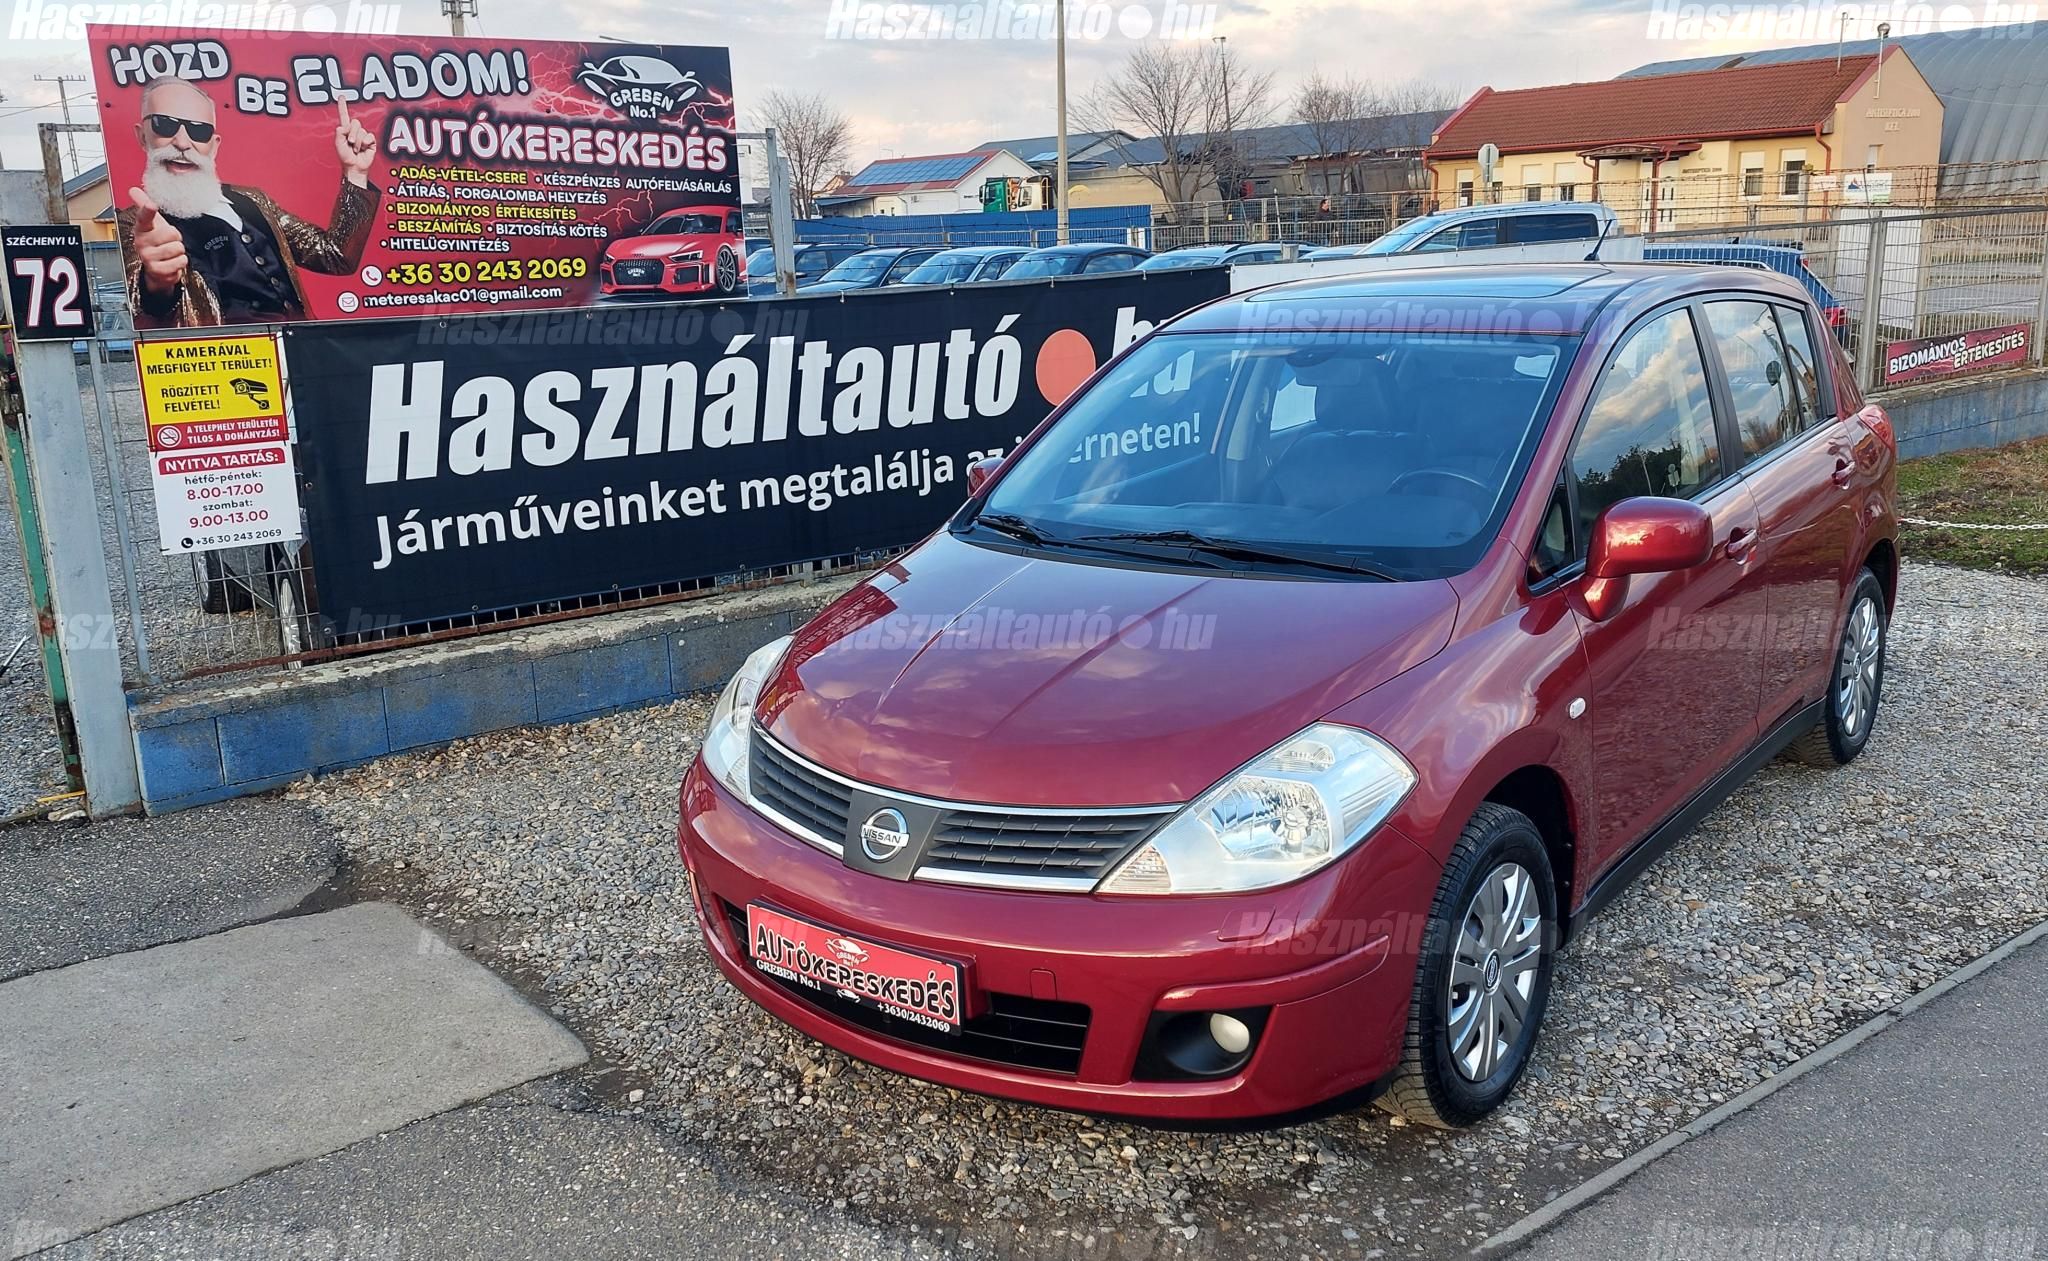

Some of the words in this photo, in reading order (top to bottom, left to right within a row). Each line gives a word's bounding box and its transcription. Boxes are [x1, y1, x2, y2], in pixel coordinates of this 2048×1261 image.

[109, 41, 231, 86] HOZD
[293, 50, 530, 104] ELADOM!
[237, 77, 289, 116] BE
[610, 88, 674, 112] GREBEN
[629, 105, 656, 120] No.1
[388, 111, 727, 170] AUTÓKERESKEDÉS
[399, 166, 527, 184] ADÁS-VÉTEL-CSERE
[543, 172, 620, 189] KÉSZPÉNZES
[625, 176, 732, 193] AUTÓFELVÁSÁRLÁS
[396, 183, 450, 201] ÁTÍRÁS,
[454, 187, 546, 203] FORGALOMBA
[548, 188, 607, 205] HELYEZÉS
[397, 200, 490, 217] BIZOMÁNYOS
[496, 203, 577, 220] ÉRTÉKESÍTÉS
[398, 219, 482, 234] BESZÁMÍTÁS
[496, 220, 566, 237] BIZTOSÍTÁS
[569, 222, 607, 238] KÖTÉS
[6, 235, 66, 247] SZÉCHENYI
[68, 235, 79, 247] U.
[390, 236, 510, 252] HITELÜGYINTÉZÉS
[386, 262, 431, 285] +36
[438, 261, 471, 284] 30
[476, 260, 523, 282] 243
[528, 257, 587, 280] 2069
[13, 256, 84, 328] 72
[165, 343, 251, 359] KAMERÁVAL
[1889, 336, 1967, 375] BIZOMÁNYOS
[1954, 330, 2025, 369] ÉRTÉKESÍTÉS
[147, 360, 217, 375] MEGFIGYELT
[222, 357, 273, 371] TERÜLET!
[161, 383, 220, 398] RÖGZÍTETT
[366, 314, 1023, 485] Használtautó
[164, 398, 221, 413] FELVÉTEL!
[194, 422, 236, 434] TELEPHELY
[236, 418, 279, 430] TERÜLETÉN
[187, 433, 213, 445] TILOS
[216, 433, 223, 442] A
[224, 428, 280, 442] DOHÁNYZÁS!
[165, 456, 220, 473] NYITVA
[222, 451, 279, 470] TARTÁS:
[184, 470, 262, 486] hétfő-péntek:
[187, 482, 264, 500] 8.00-17.00
[202, 500, 253, 512] szombat:
[374, 473, 728, 571] Járműveinket
[739, 446, 955, 512] megtalálja
[189, 509, 269, 529] 9.00-13.00
[195, 535, 216, 546] +36
[217, 534, 231, 544] 30
[233, 531, 254, 542] 243
[255, 528, 282, 540] 2069
[862, 827, 902, 845] NISSAN
[755, 922, 956, 1020] AUTÓKERESKEDÉS
[756, 960, 798, 983] GREBEN
[799, 974, 822, 991] No.1
[877, 1001, 951, 1034] +3630/2432069
